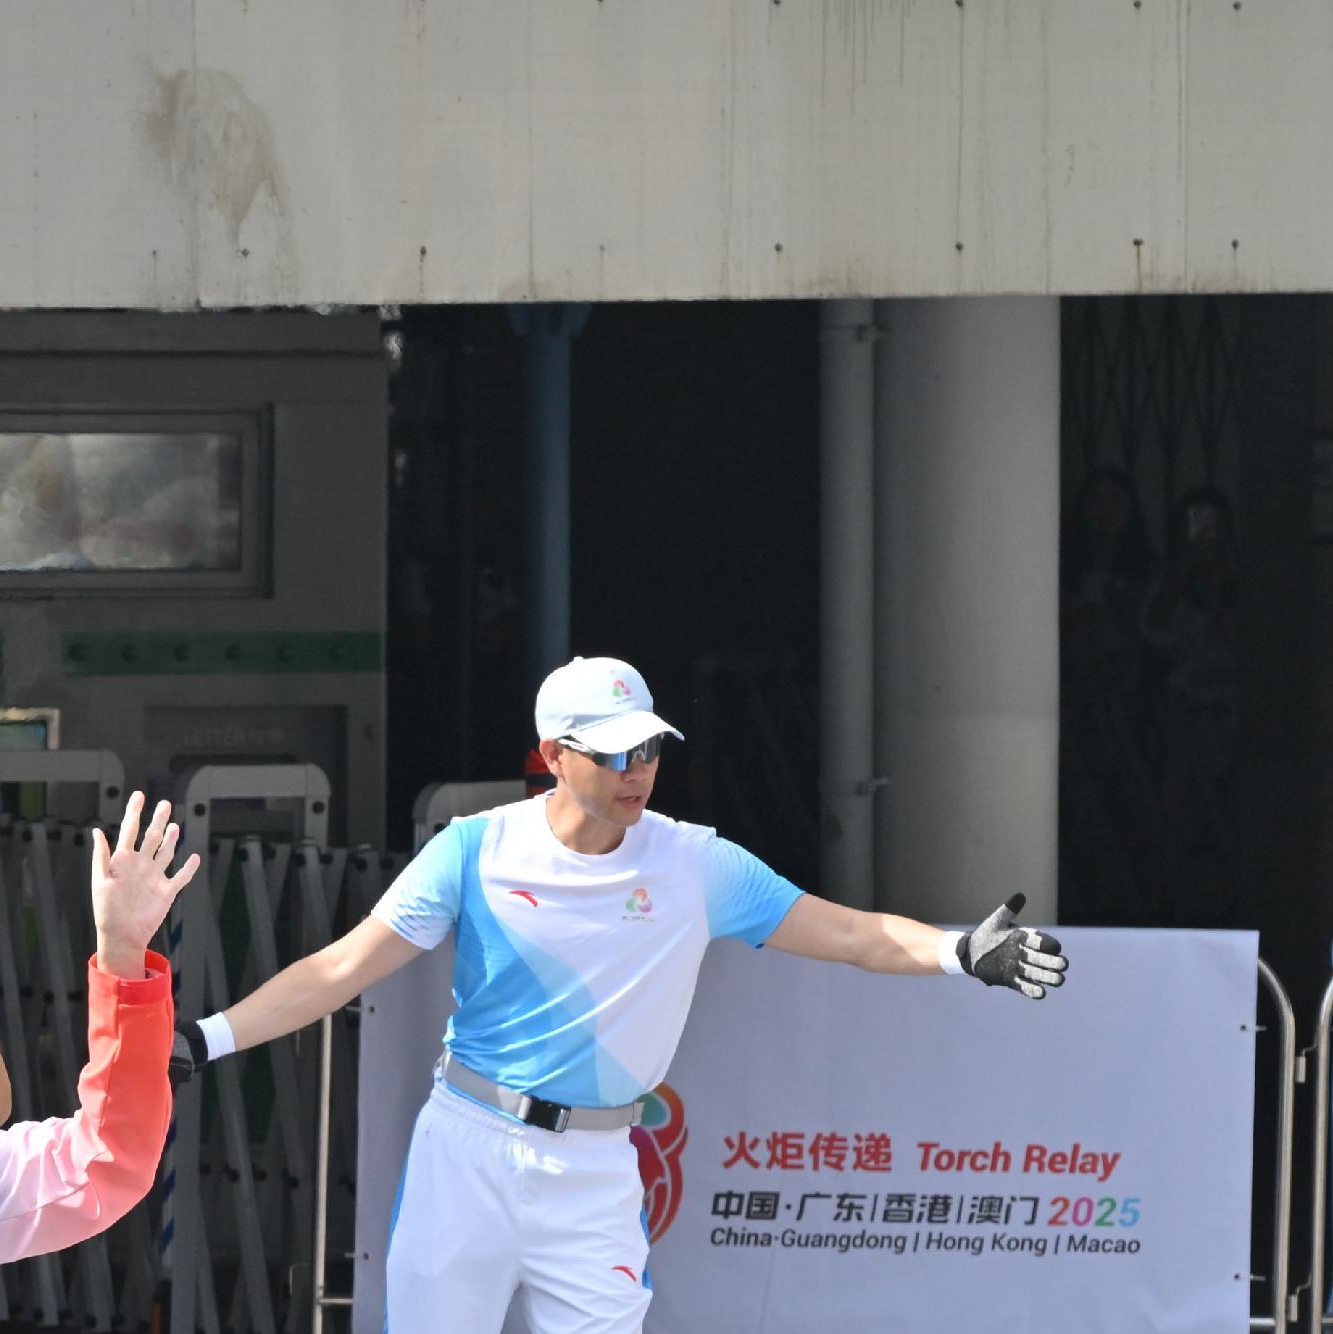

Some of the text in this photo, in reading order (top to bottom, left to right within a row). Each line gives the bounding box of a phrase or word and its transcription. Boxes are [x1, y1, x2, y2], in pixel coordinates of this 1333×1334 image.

[723, 1131, 1121, 1182] 火炬传递 Torch Relay
[1047, 1196, 1142, 1227] 2025
[926, 1232, 985, 1256] Hong
[991, 1233, 1047, 1256] Kong
[1067, 1235, 1141, 1254] Macao
